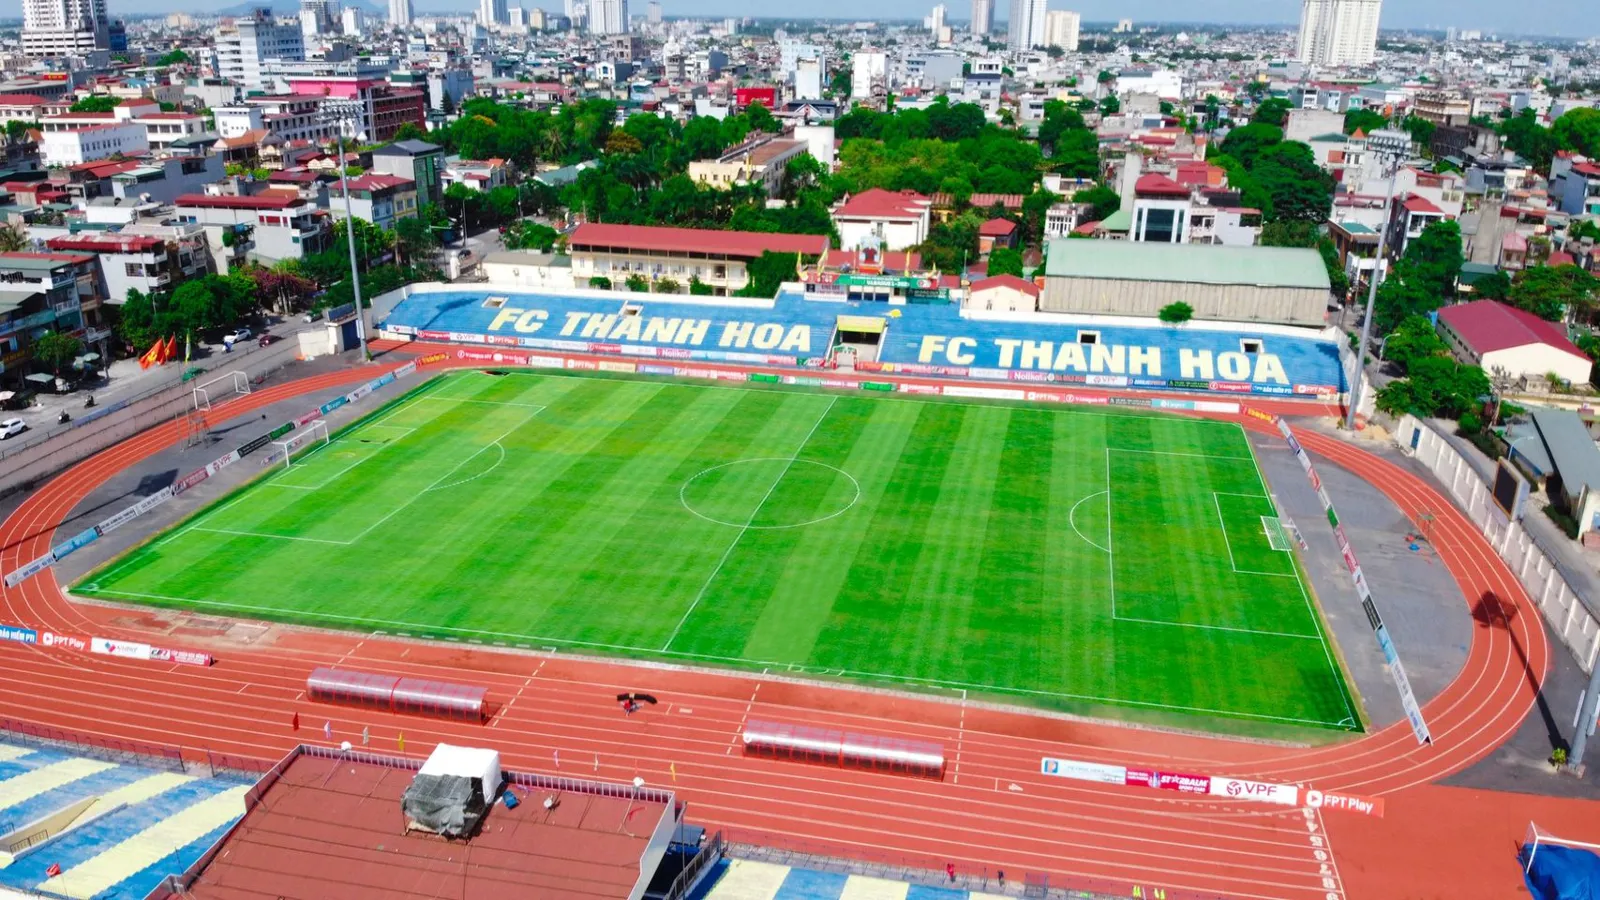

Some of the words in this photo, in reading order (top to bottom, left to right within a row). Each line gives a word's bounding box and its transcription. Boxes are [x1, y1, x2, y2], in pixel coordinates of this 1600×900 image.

[487, 308, 549, 333] FC
[559, 311, 711, 345] THANH
[718, 320, 811, 352] HOA
[918, 335, 977, 365] FC
[994, 338, 1161, 376] THANH
[1179, 348, 1290, 385] HOA
[54, 635, 69, 646] FPT
[69, 637, 86, 651] Play
[1244, 782, 1277, 796] VPF
[1324, 794, 1348, 808] FPT
[1348, 797, 1374, 815] Play
